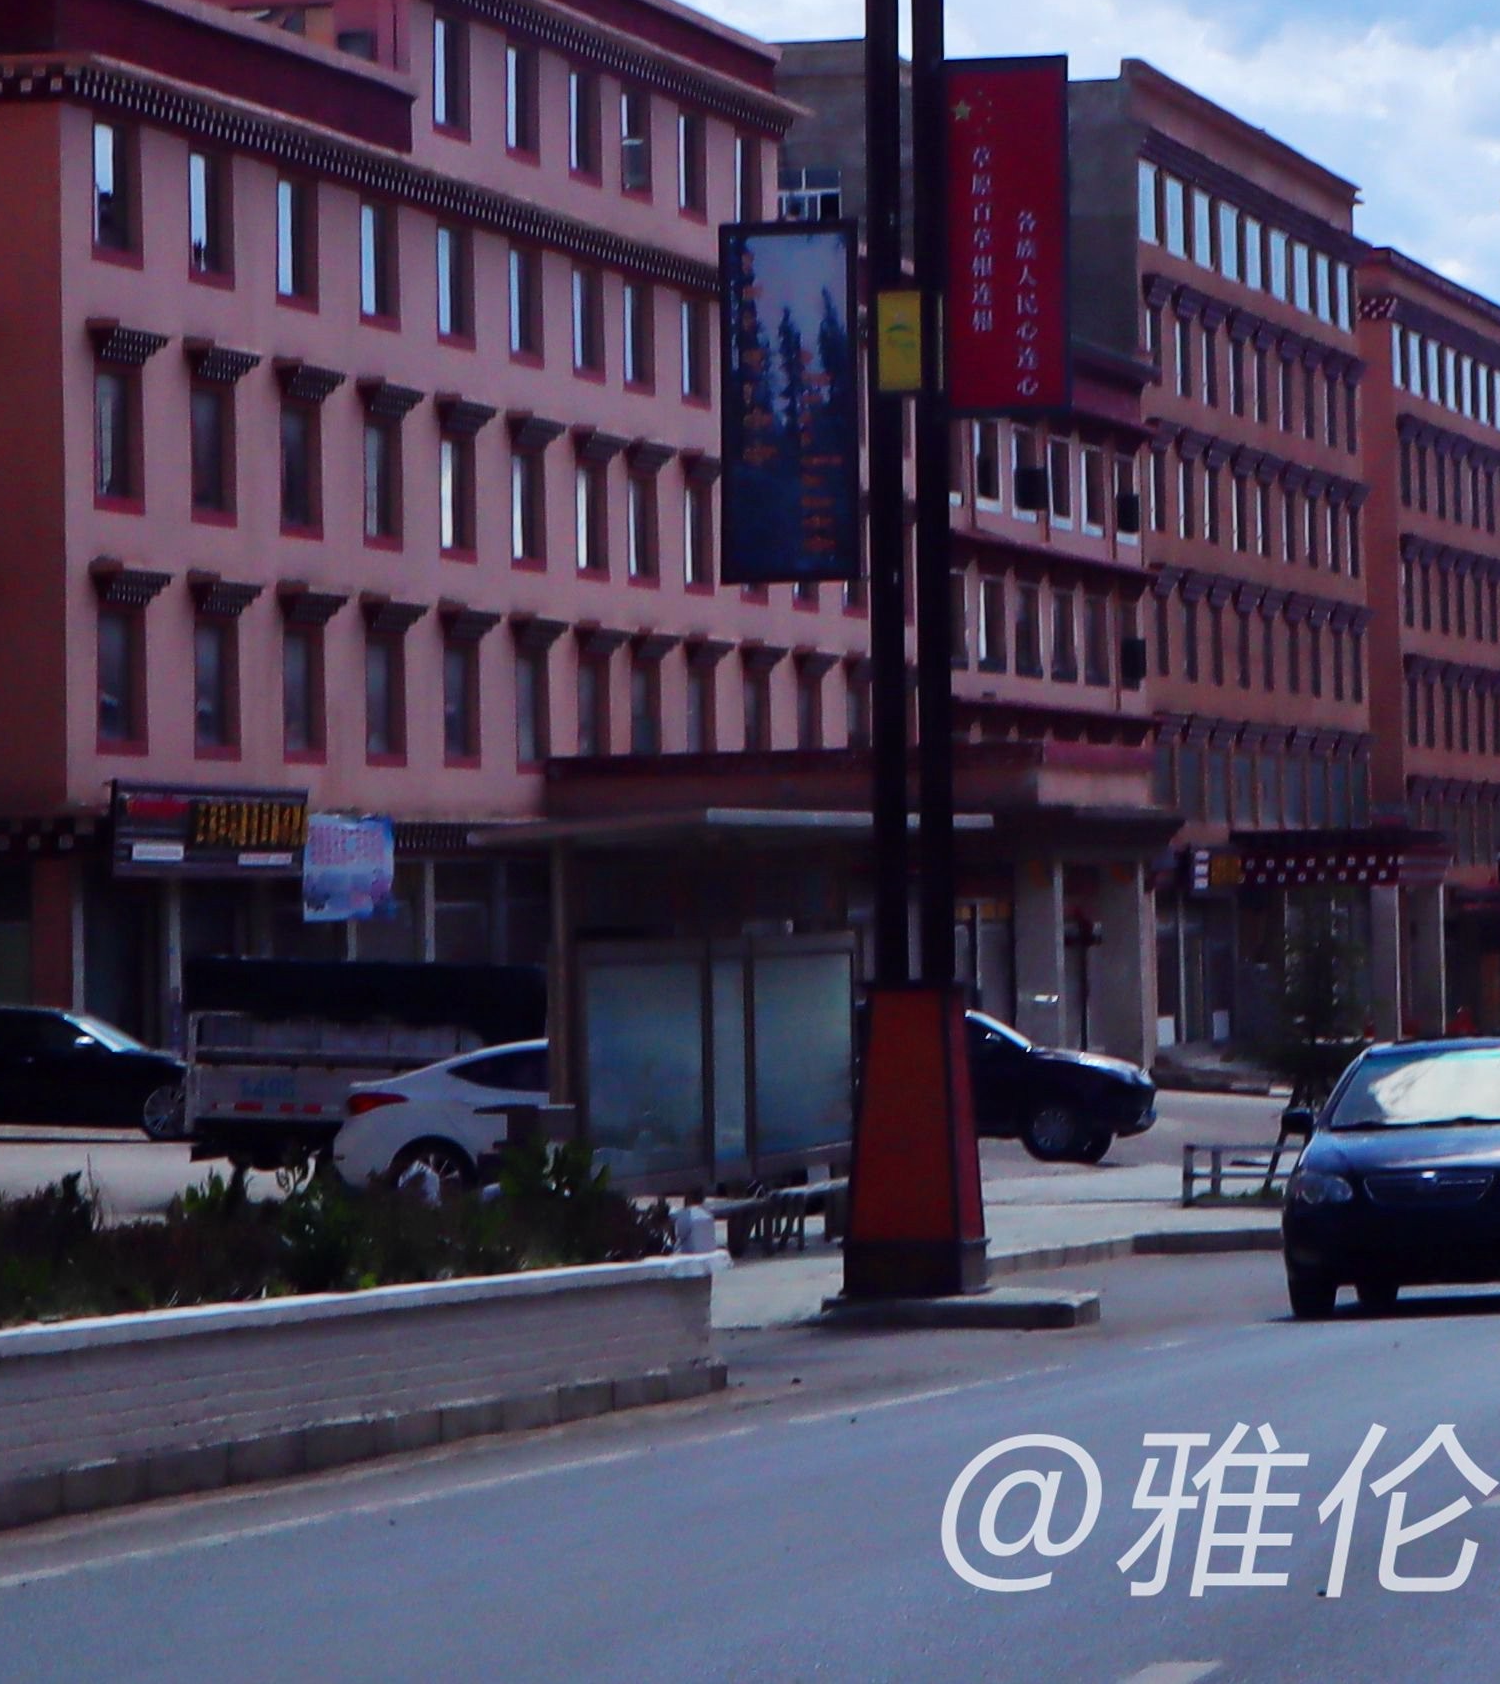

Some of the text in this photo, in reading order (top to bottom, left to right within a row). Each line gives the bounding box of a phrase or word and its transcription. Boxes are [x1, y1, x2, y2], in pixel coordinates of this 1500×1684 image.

[1015, 209, 1040, 397] 各族人民心连心
